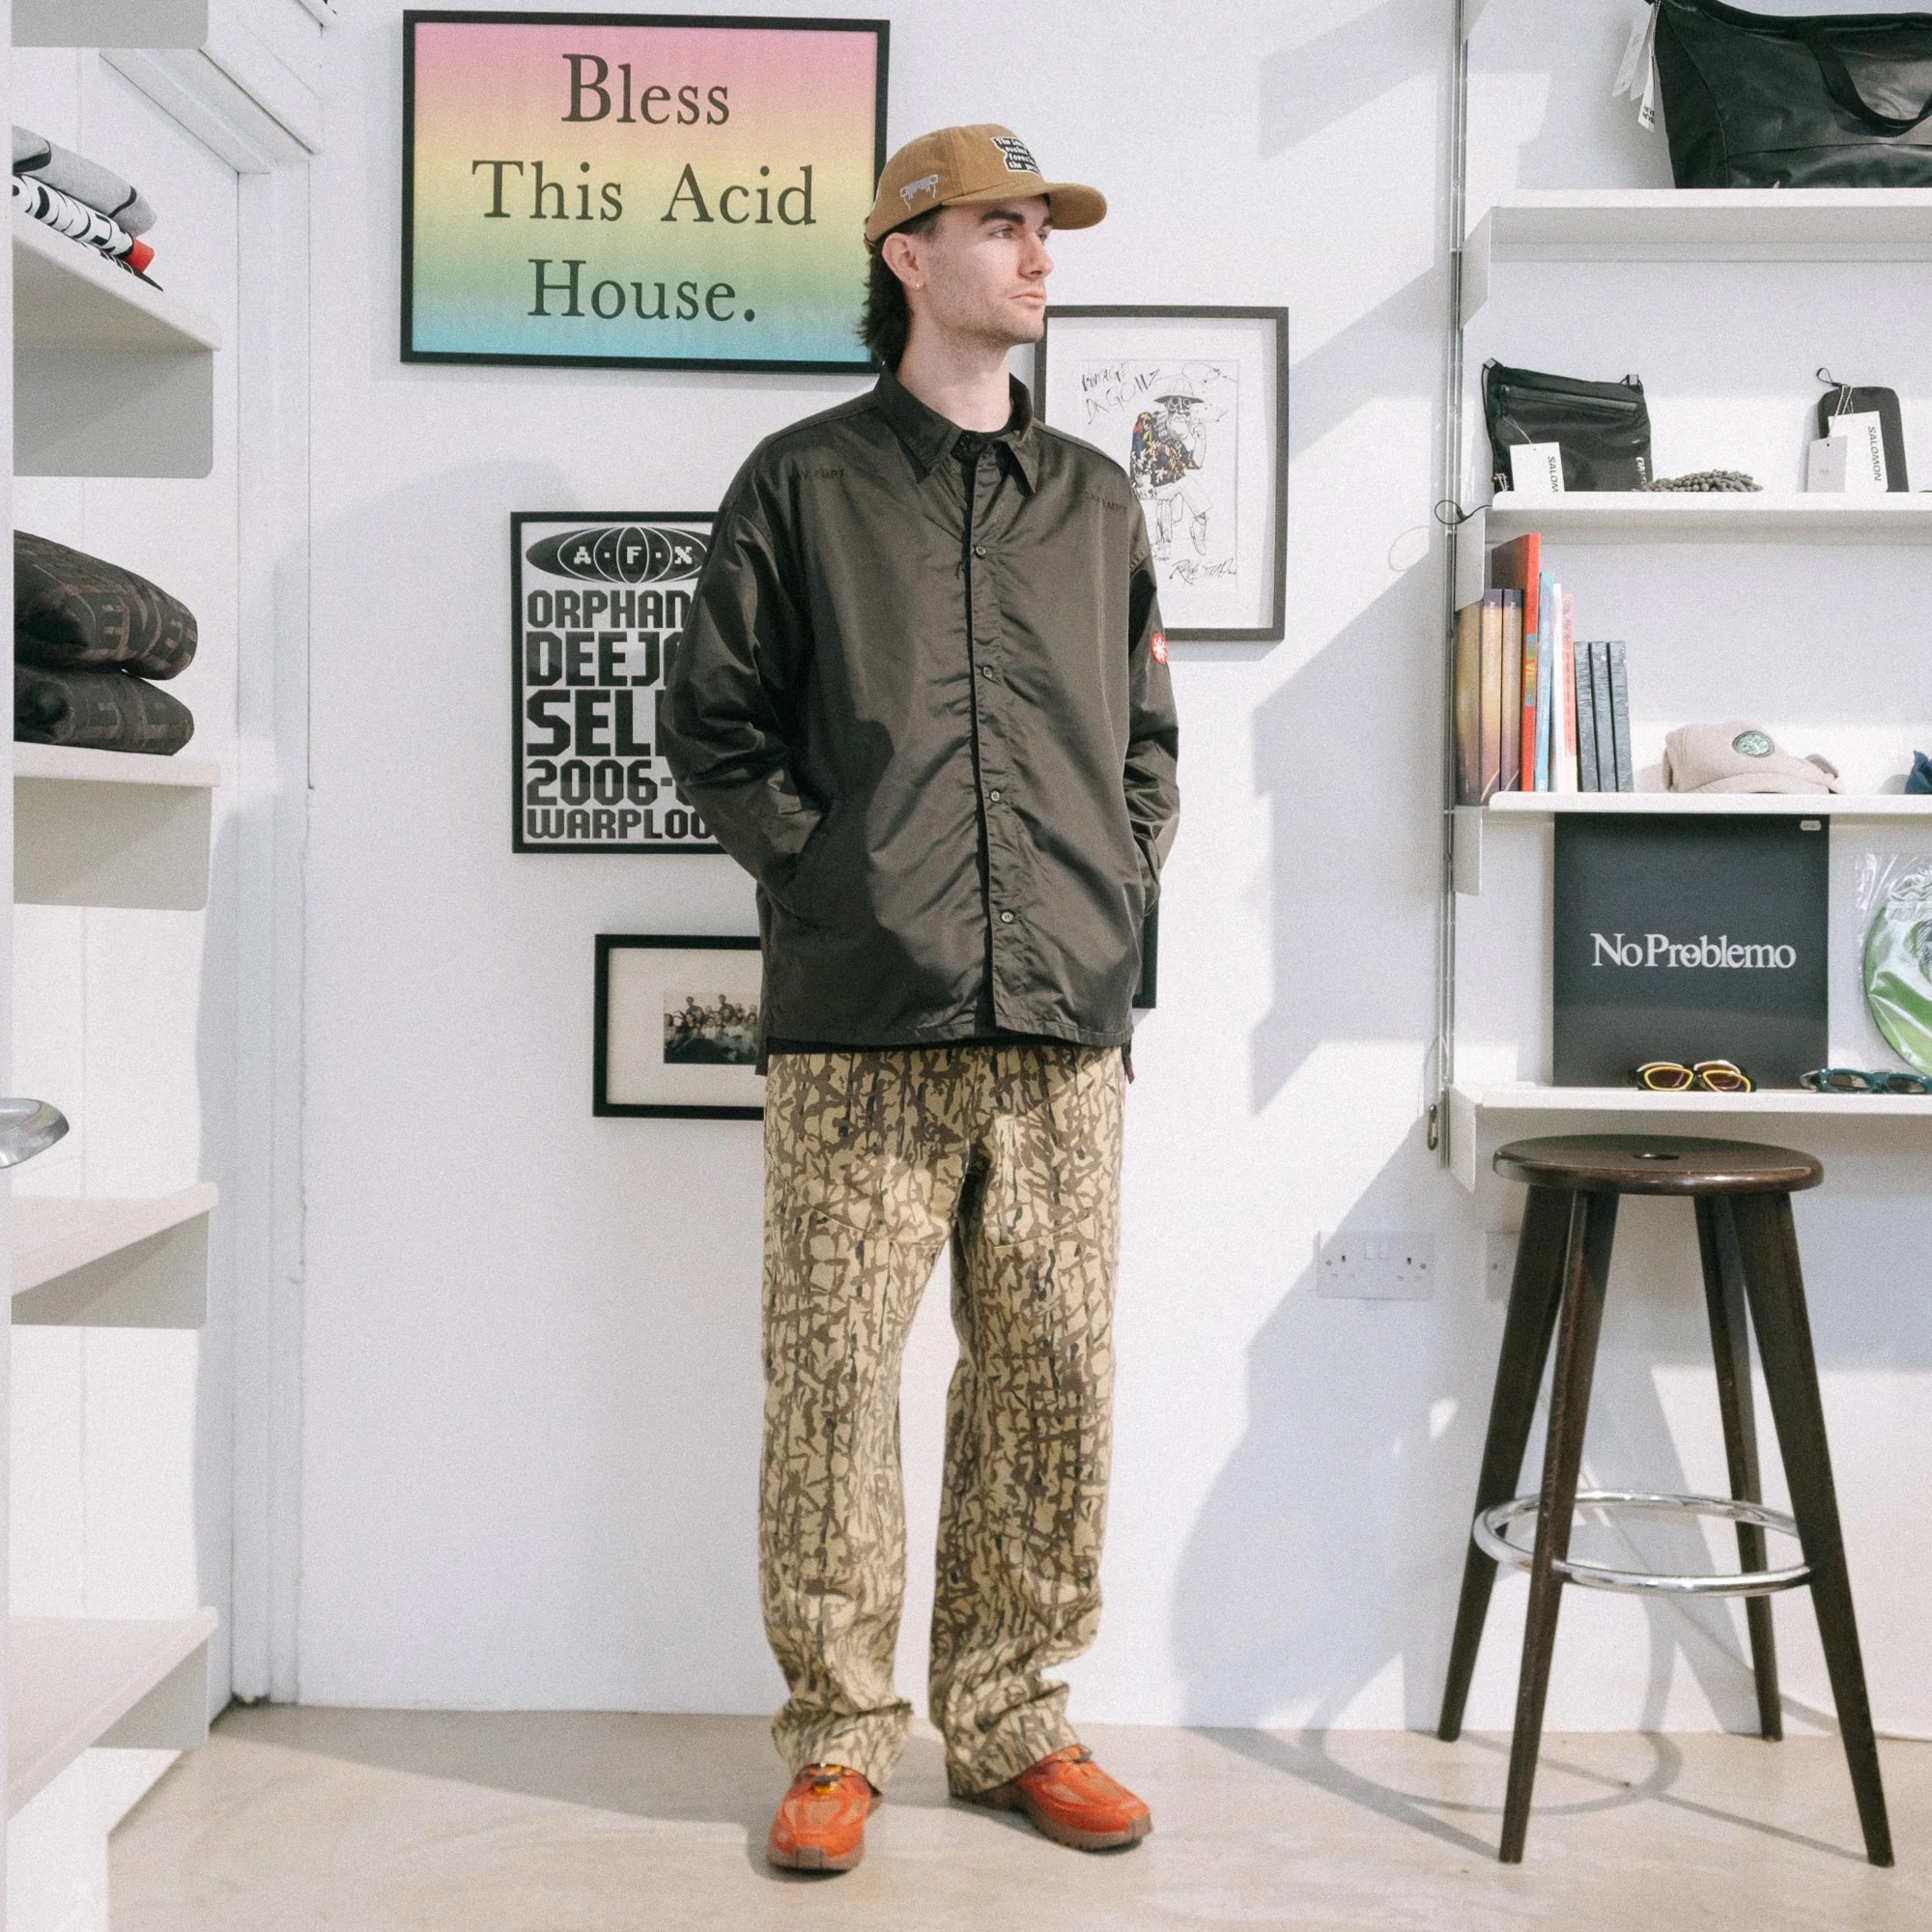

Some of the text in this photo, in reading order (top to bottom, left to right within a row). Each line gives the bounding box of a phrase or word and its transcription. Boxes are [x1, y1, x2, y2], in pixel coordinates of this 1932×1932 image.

[560, 53, 730, 126] Bless
[471, 158, 817, 226] This Acid
[526, 258, 756, 323] House.
[1867, 425, 1883, 481] SALOMON
[526, 690, 667, 756] SEL
[526, 759, 694, 806] 2006-
